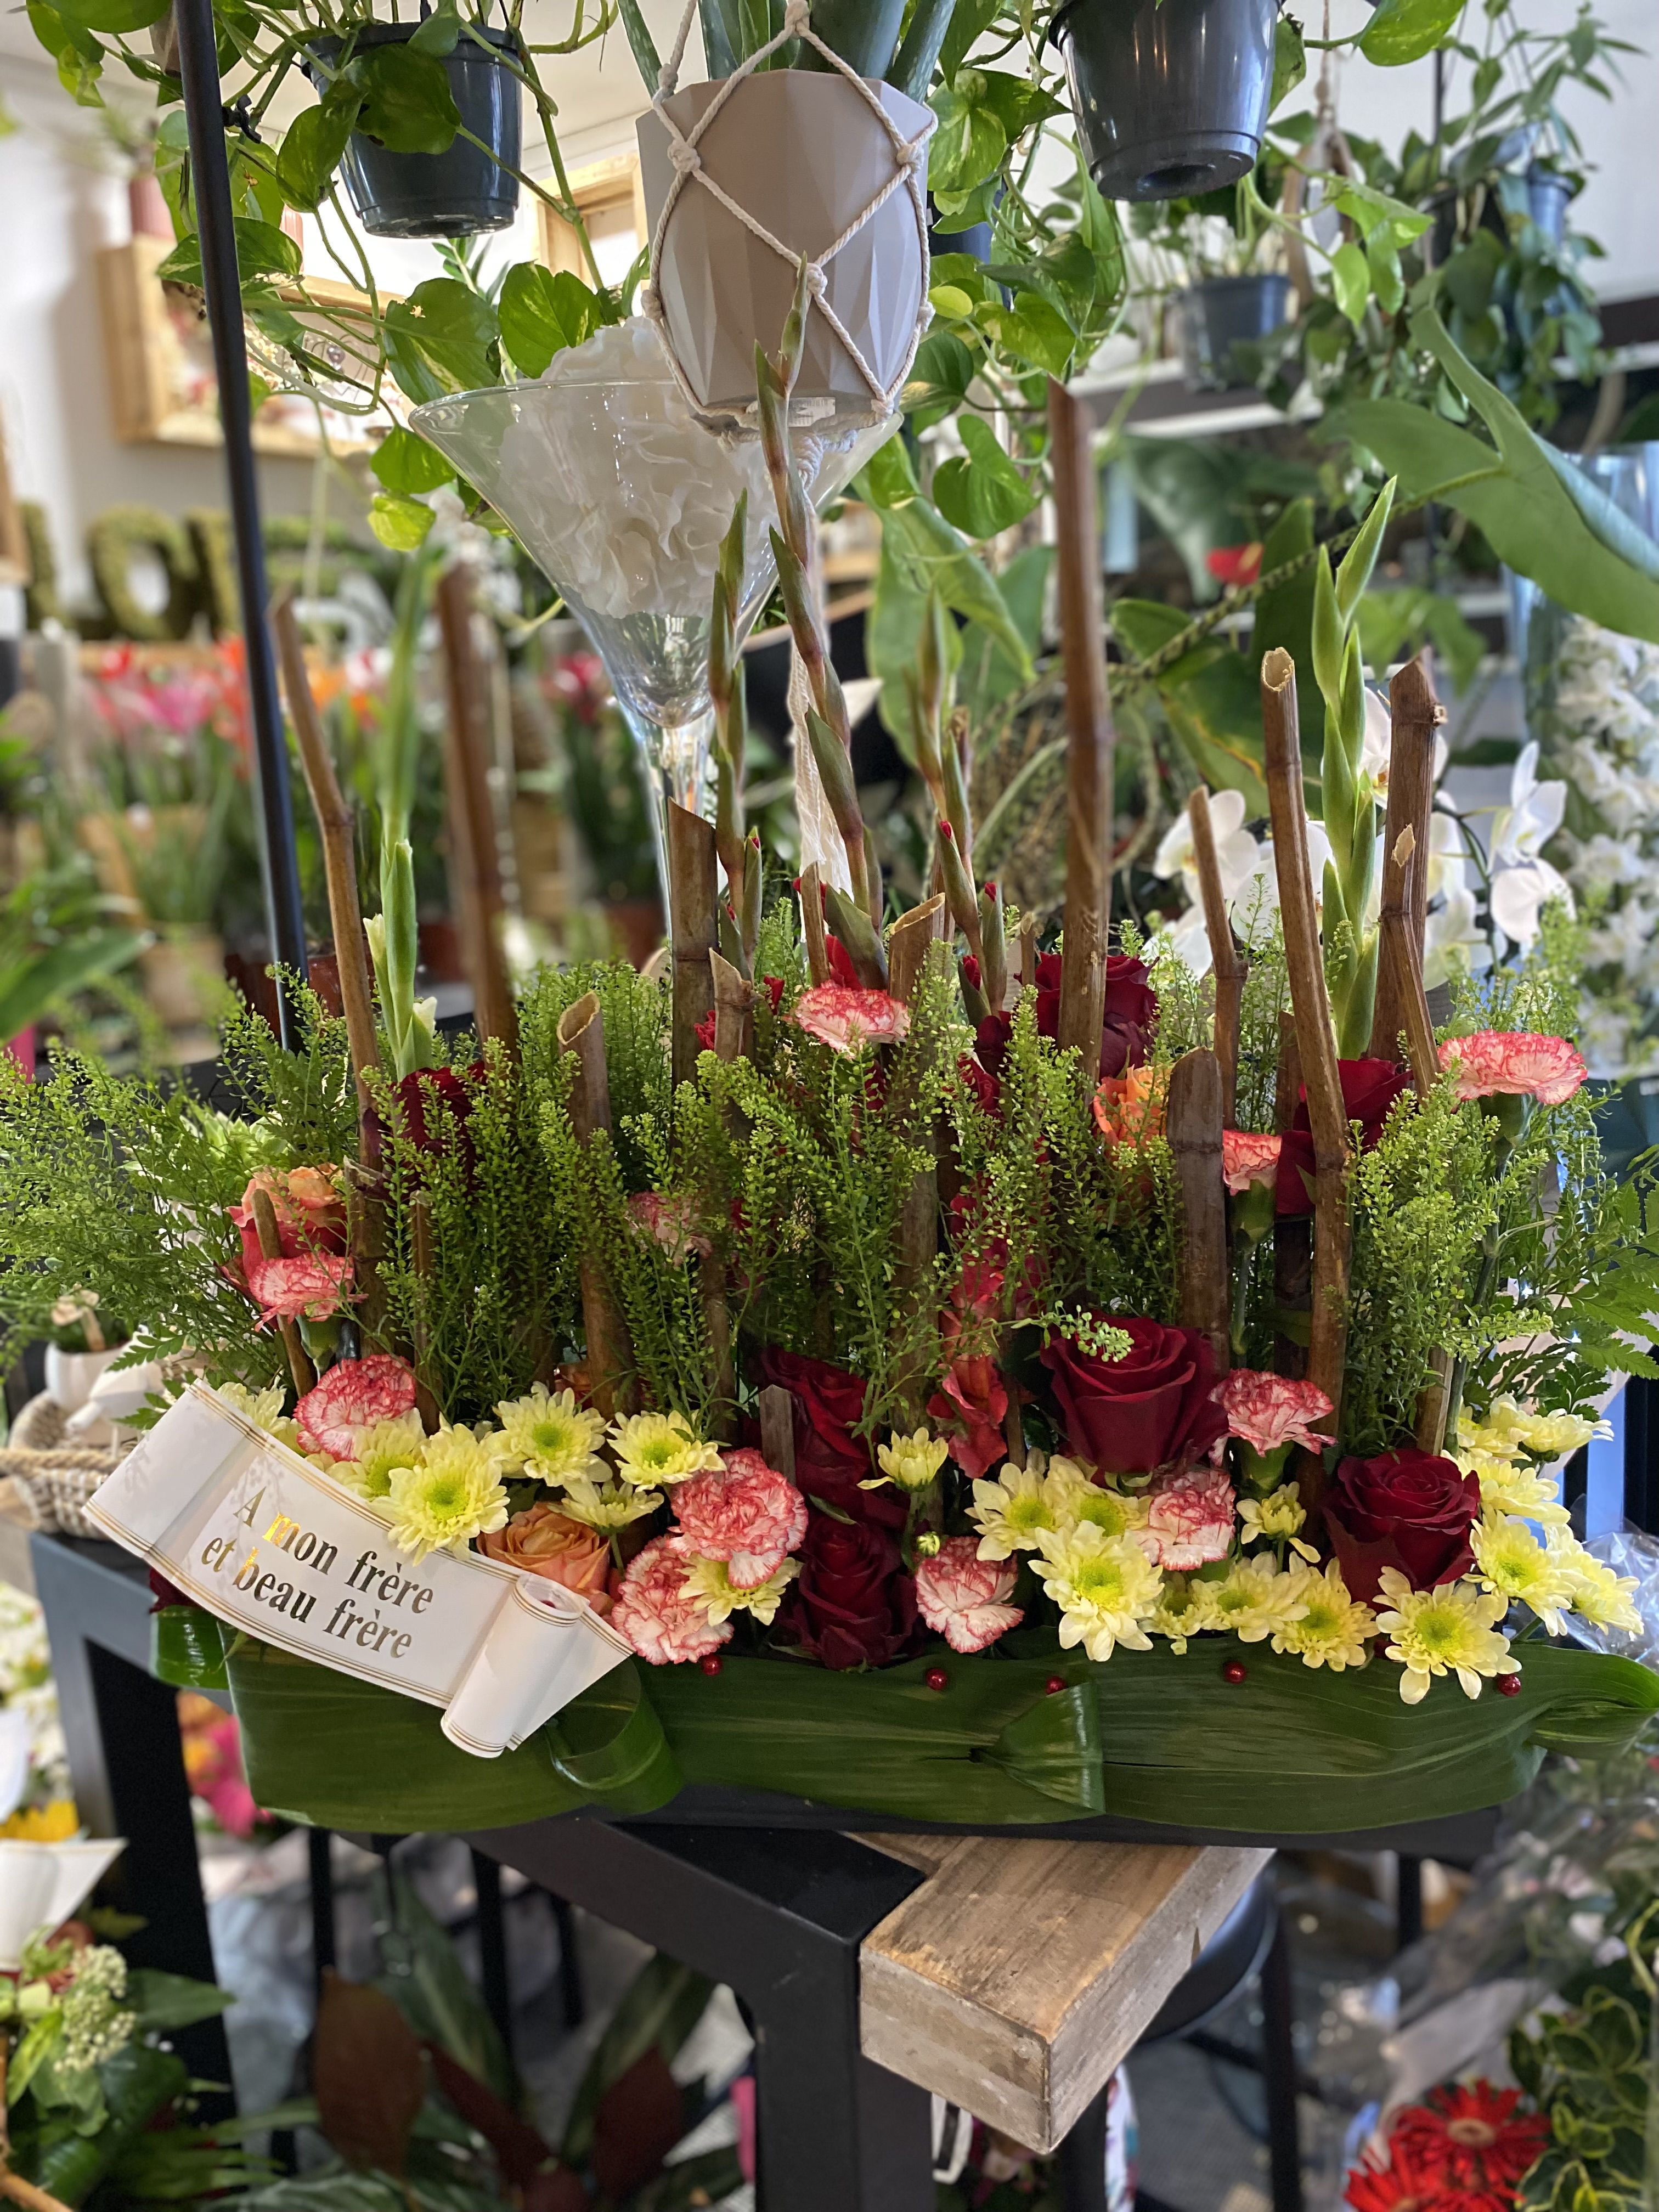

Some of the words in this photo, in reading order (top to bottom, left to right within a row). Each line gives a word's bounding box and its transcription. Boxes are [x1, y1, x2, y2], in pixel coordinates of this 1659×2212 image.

[201, 1537, 237, 1572] et
[232, 1546, 317, 1623] beau
[323, 1598, 413, 1658] frère
[233, 1486, 266, 1527] A
[263, 1511, 338, 1575] mon
[344, 1550, 433, 1613] frère
